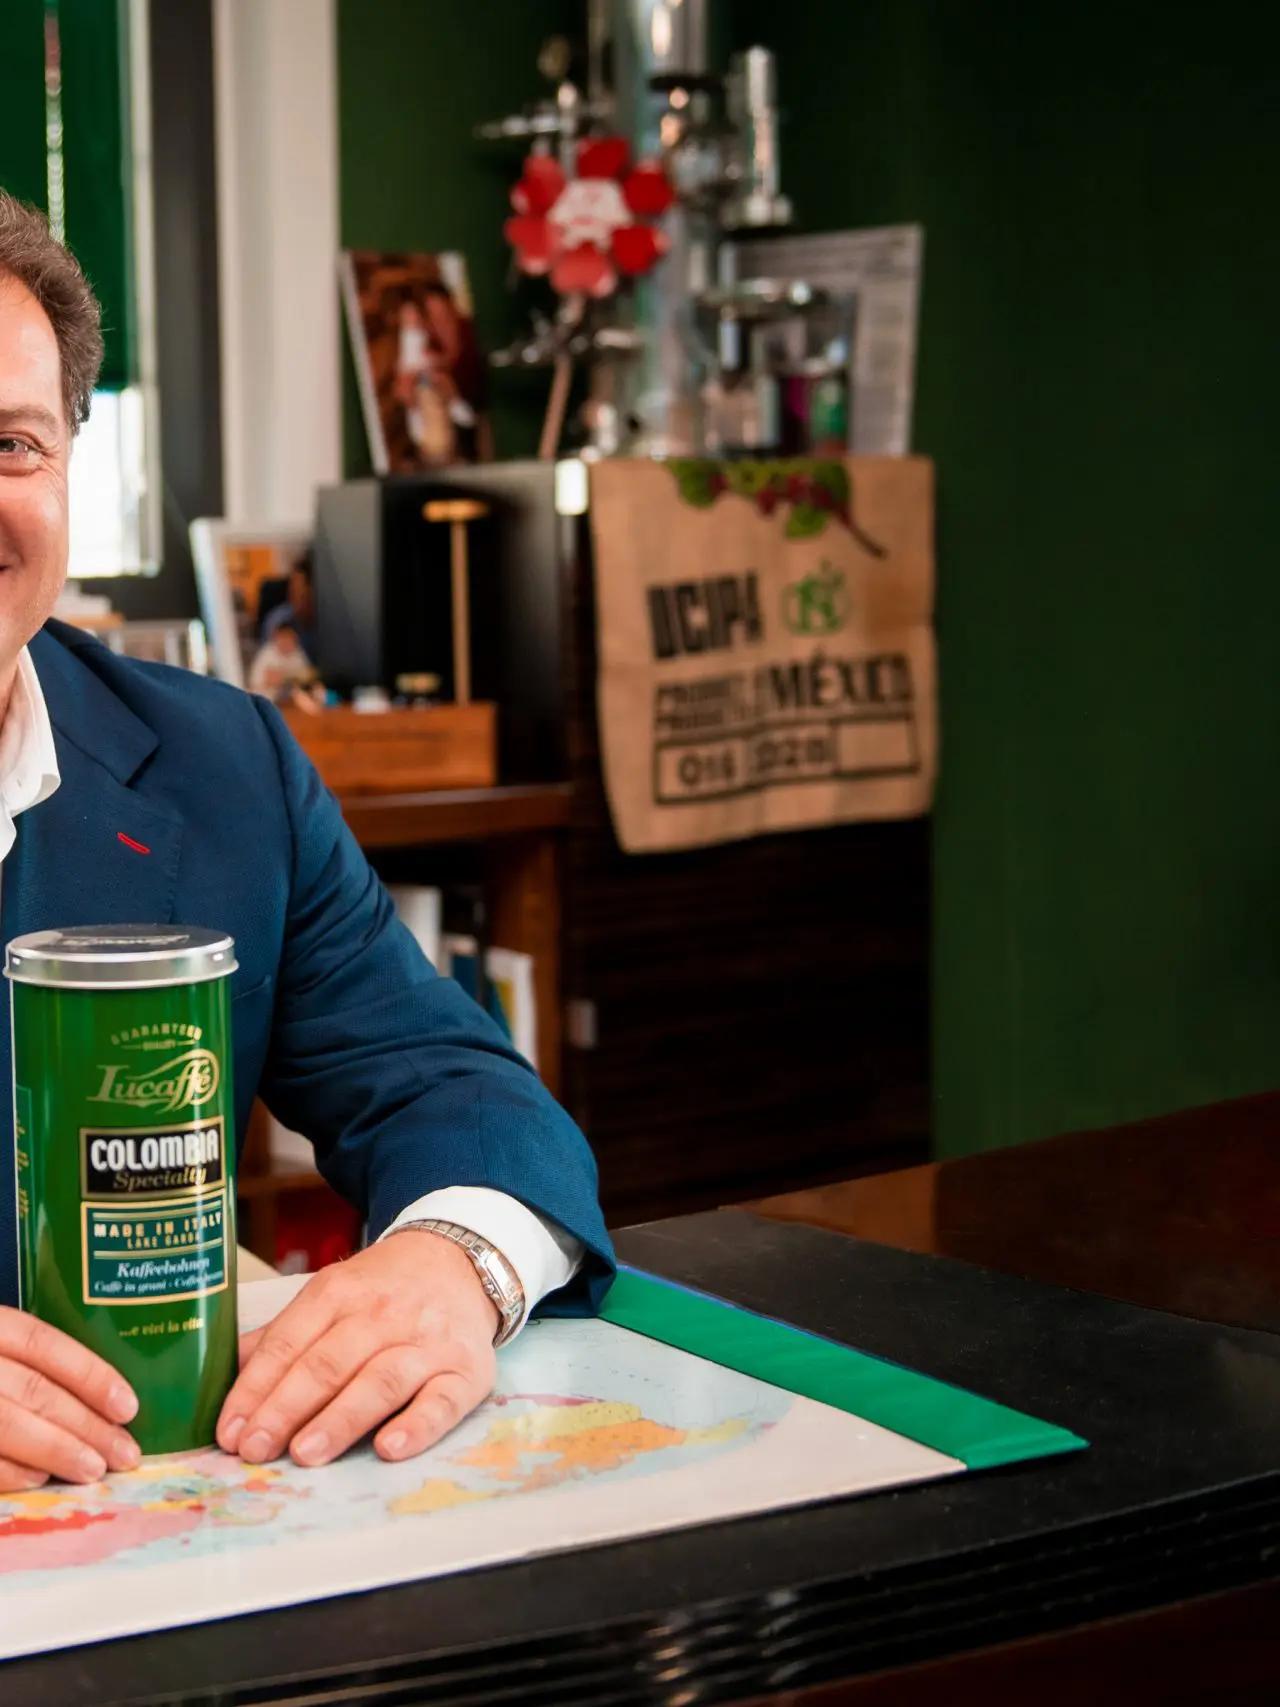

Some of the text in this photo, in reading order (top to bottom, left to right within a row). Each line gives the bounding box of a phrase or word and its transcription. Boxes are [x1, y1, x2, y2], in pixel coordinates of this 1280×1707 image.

[110, 1022, 203, 1046] GUARANTEED
[90, 1129, 220, 1173] COLOMBIA
[113, 1165, 207, 1192] Specialty
[93, 1211, 222, 1238] MADE IN ITALY
[116, 1258, 210, 1280] Kaffeebohnen
